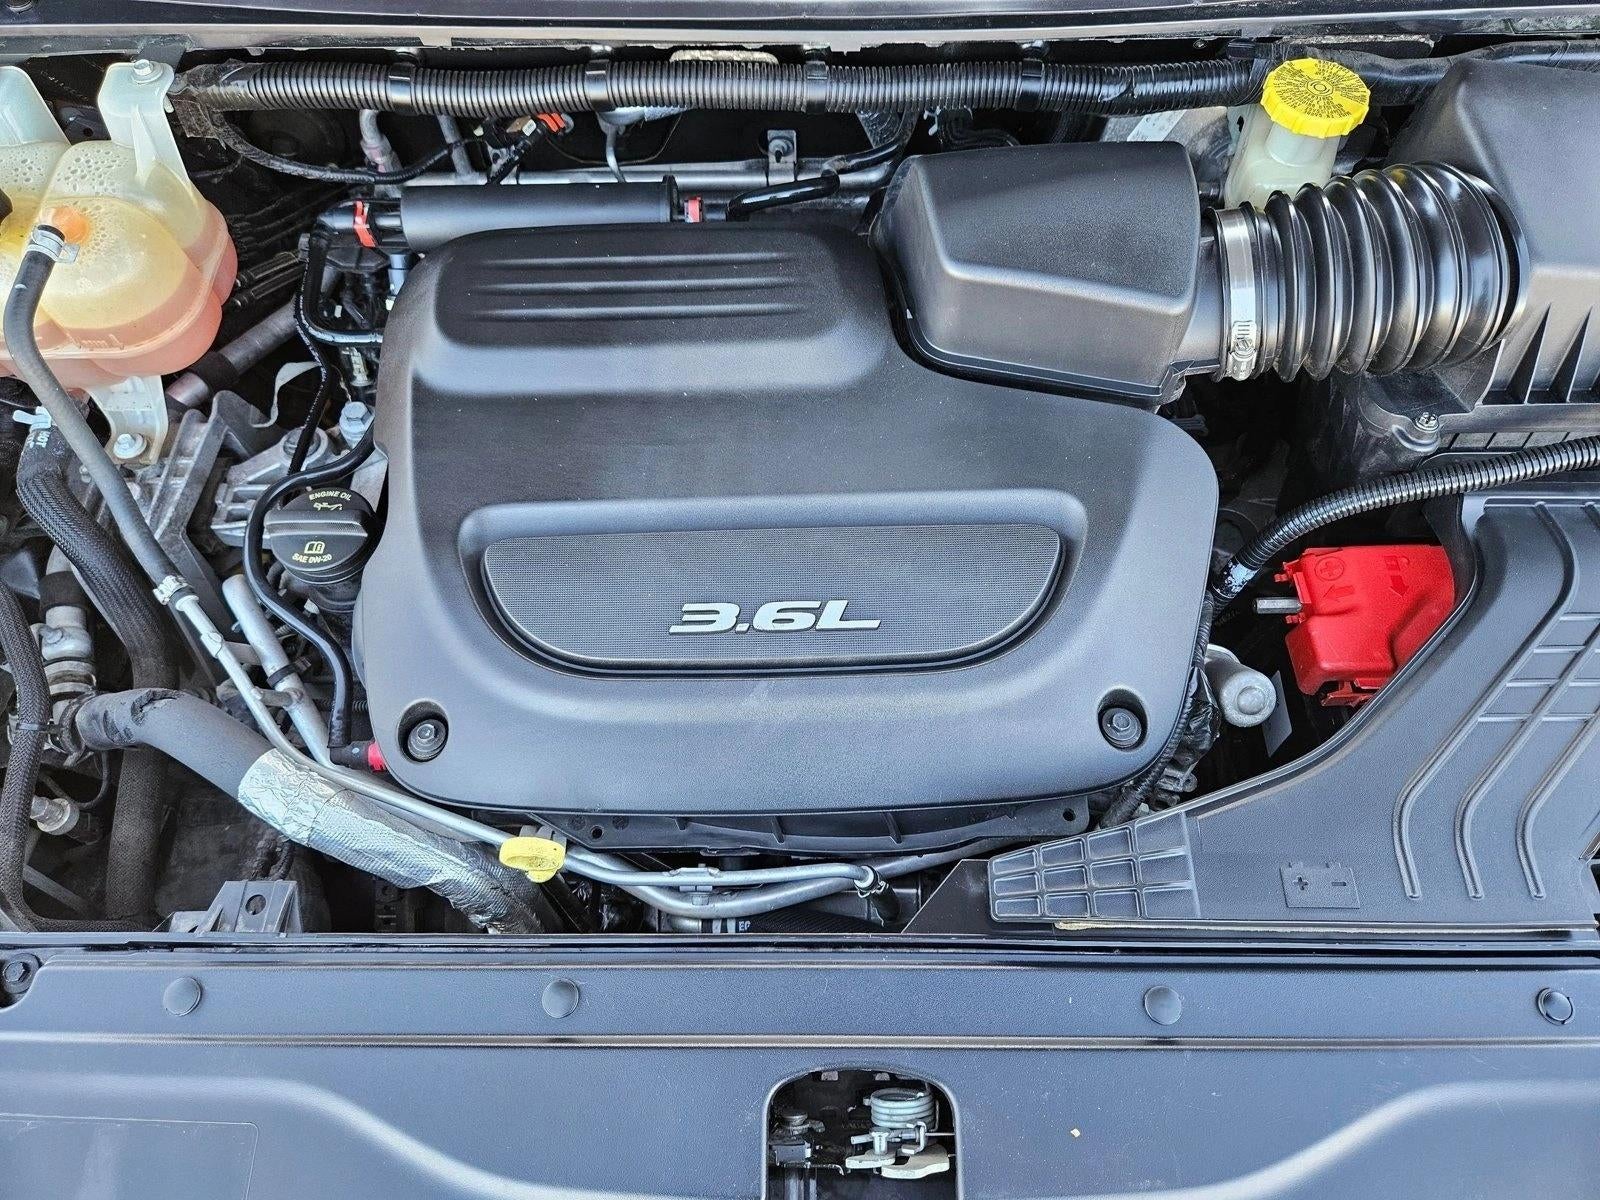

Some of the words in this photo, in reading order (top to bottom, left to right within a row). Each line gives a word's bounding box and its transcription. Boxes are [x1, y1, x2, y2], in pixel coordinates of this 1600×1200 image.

[309, 490, 340, 501] ENGINE
[340, 491, 352, 501] OIL
[292, 553, 309, 563] SAE
[309, 553, 332, 563] 0W-20
[669, 600, 882, 636] 3.6L
